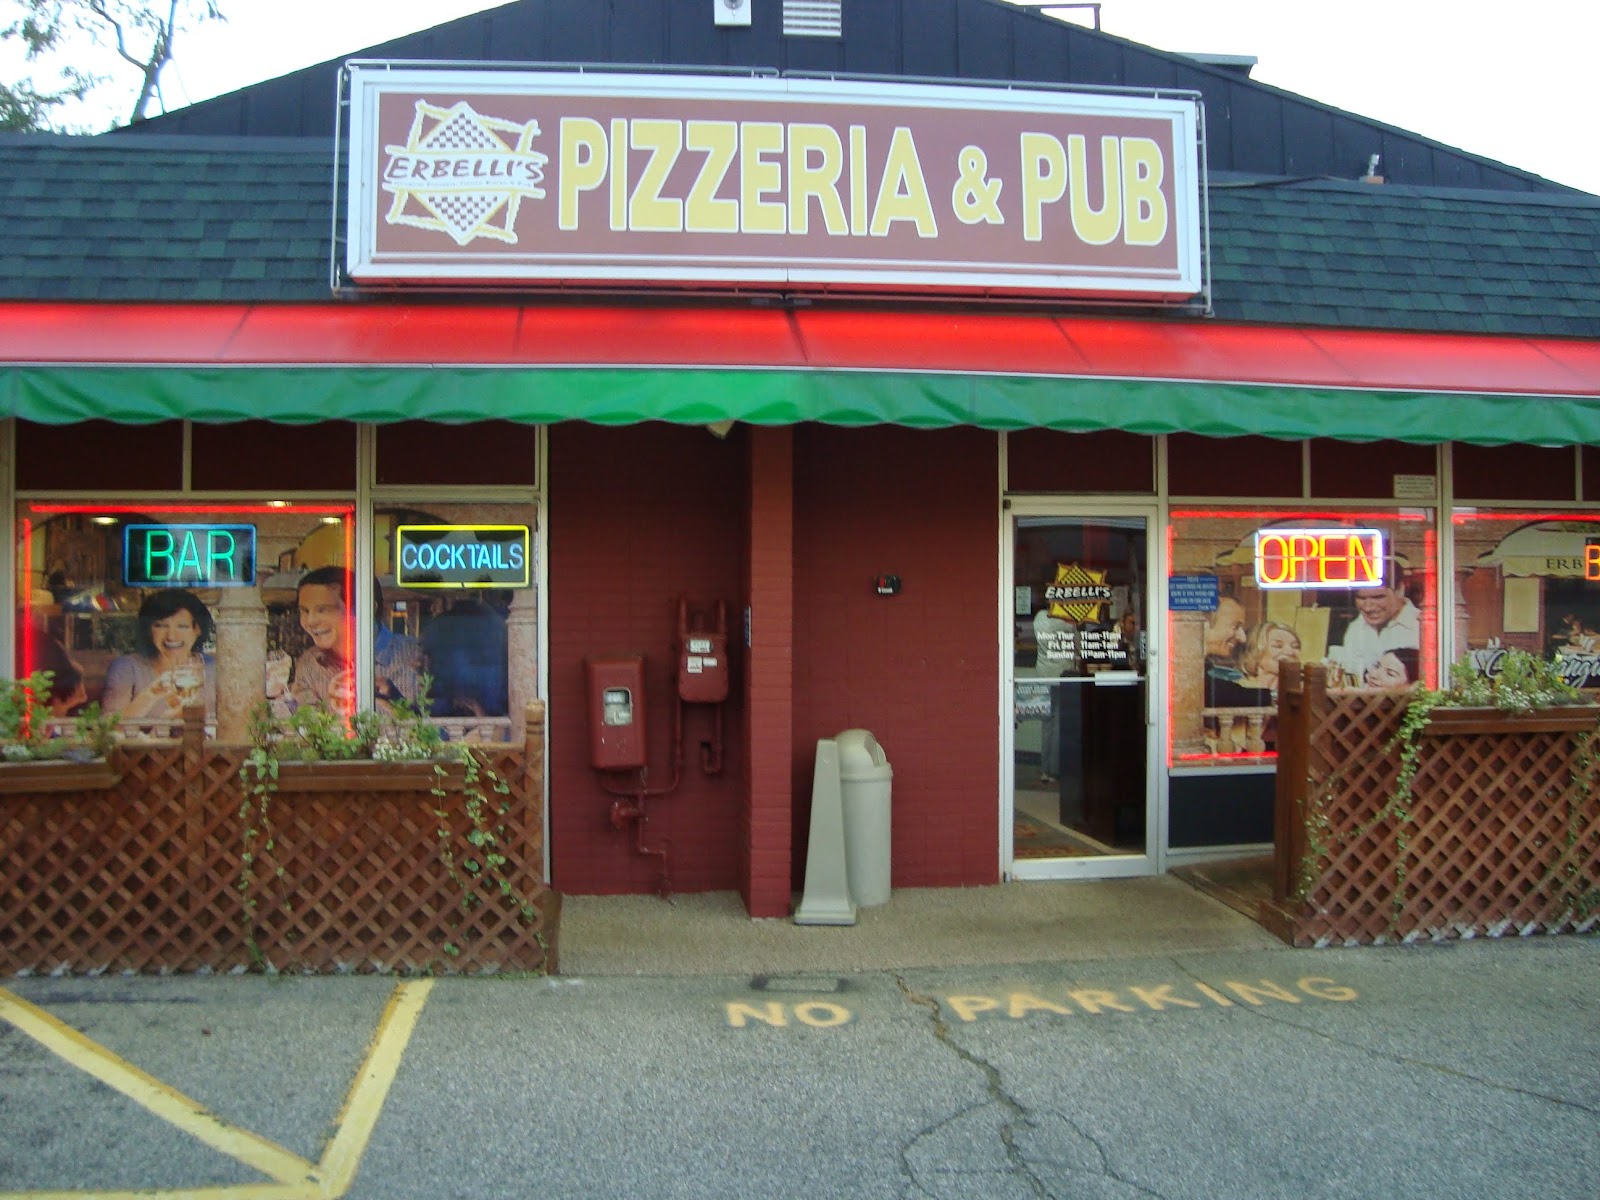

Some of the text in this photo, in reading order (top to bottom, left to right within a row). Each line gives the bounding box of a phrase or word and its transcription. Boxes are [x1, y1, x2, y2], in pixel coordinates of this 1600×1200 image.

[387, 157, 541, 181] ERBELLI'S
[558, 117, 1168, 245] PIZZERIA & PUB
[145, 530, 237, 581] BAR
[402, 543, 523, 570] COCKTAILS
[1258, 533, 1379, 584] OPEN
[1045, 586, 1111, 600] ERBELLI'S
[726, 976, 1358, 1027] NO PARKING
